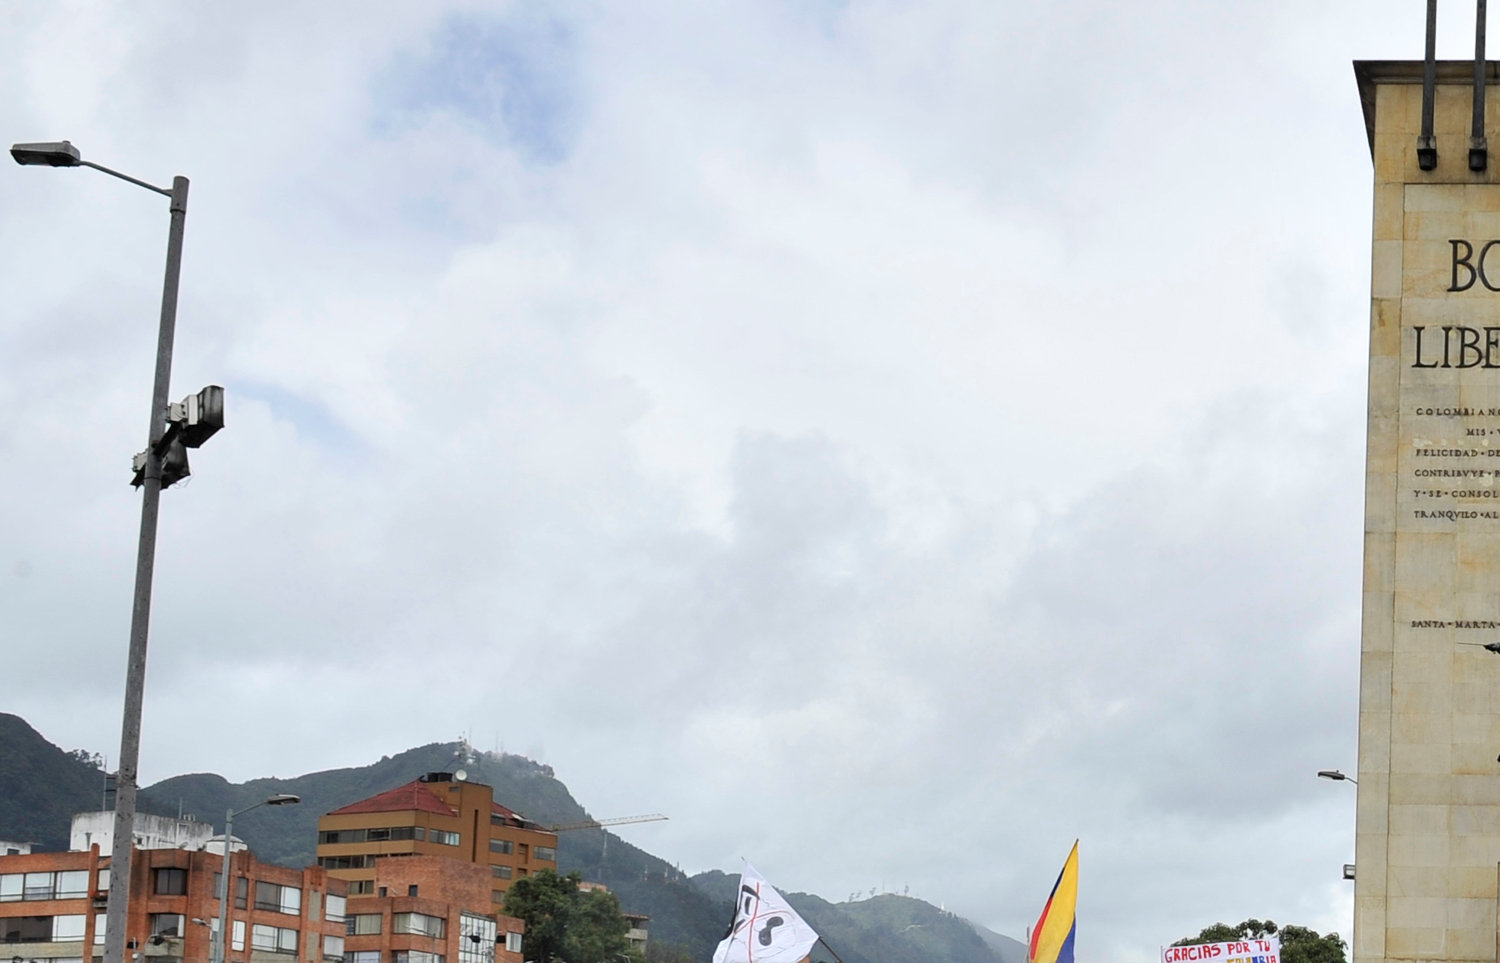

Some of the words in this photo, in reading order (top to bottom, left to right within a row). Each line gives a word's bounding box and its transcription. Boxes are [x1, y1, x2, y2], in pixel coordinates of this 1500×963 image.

[1466, 428, 1486, 436] MIS
[1416, 449, 1478, 457] FELICIDAD
[1413, 490, 1421, 498] Y
[1428, 490, 1442, 498] SE
[1484, 510, 1500, 519] AL
[1411, 620, 1445, 629] SANTA
[1455, 620, 1496, 629] MARTA
[1164, 944, 1222, 963] GRACIAS
[1227, 942, 1251, 956] POR
[1255, 940, 1271, 952] TU
